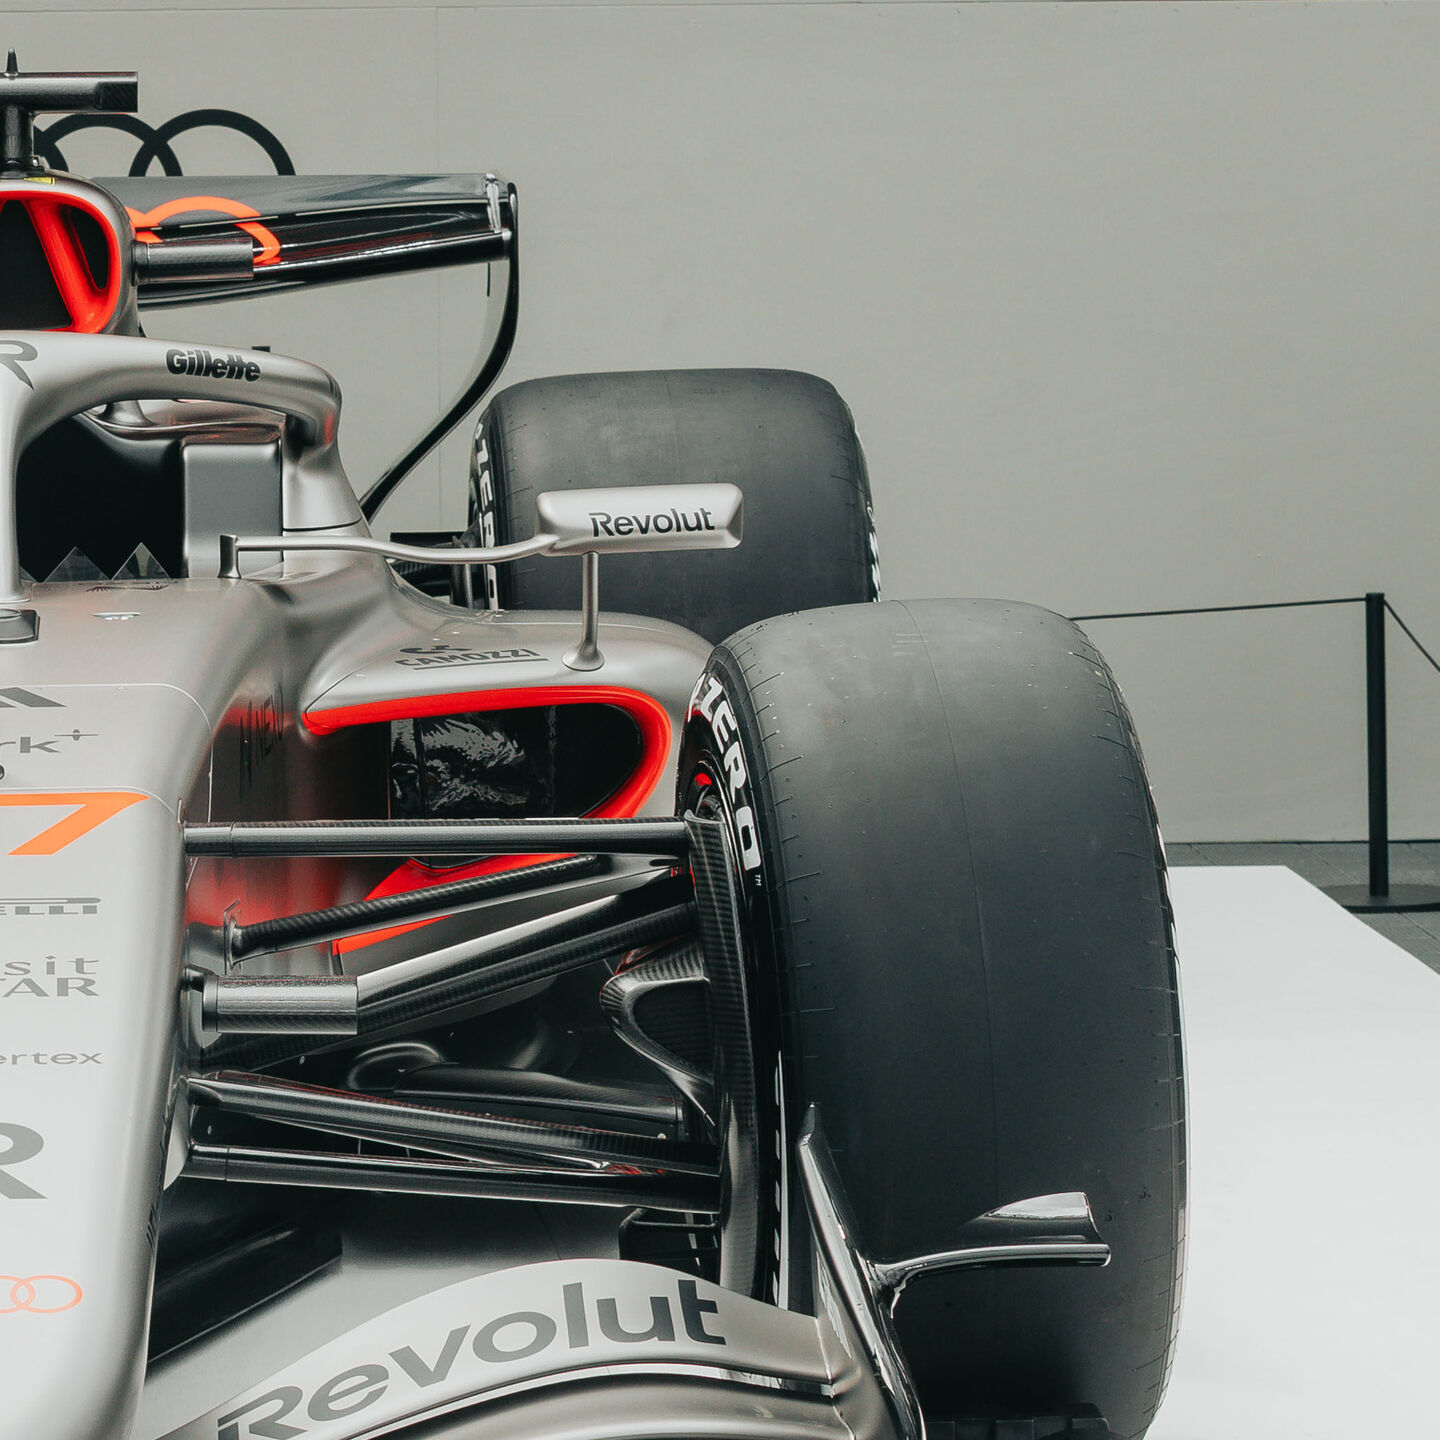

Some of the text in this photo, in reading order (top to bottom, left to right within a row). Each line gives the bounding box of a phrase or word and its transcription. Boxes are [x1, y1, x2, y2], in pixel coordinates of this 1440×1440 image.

[166, 347, 260, 385] Gillette
[588, 507, 715, 537] Revolut
[394, 648, 541, 667] CAMOZZI
[700, 676, 762, 871] ZERO
